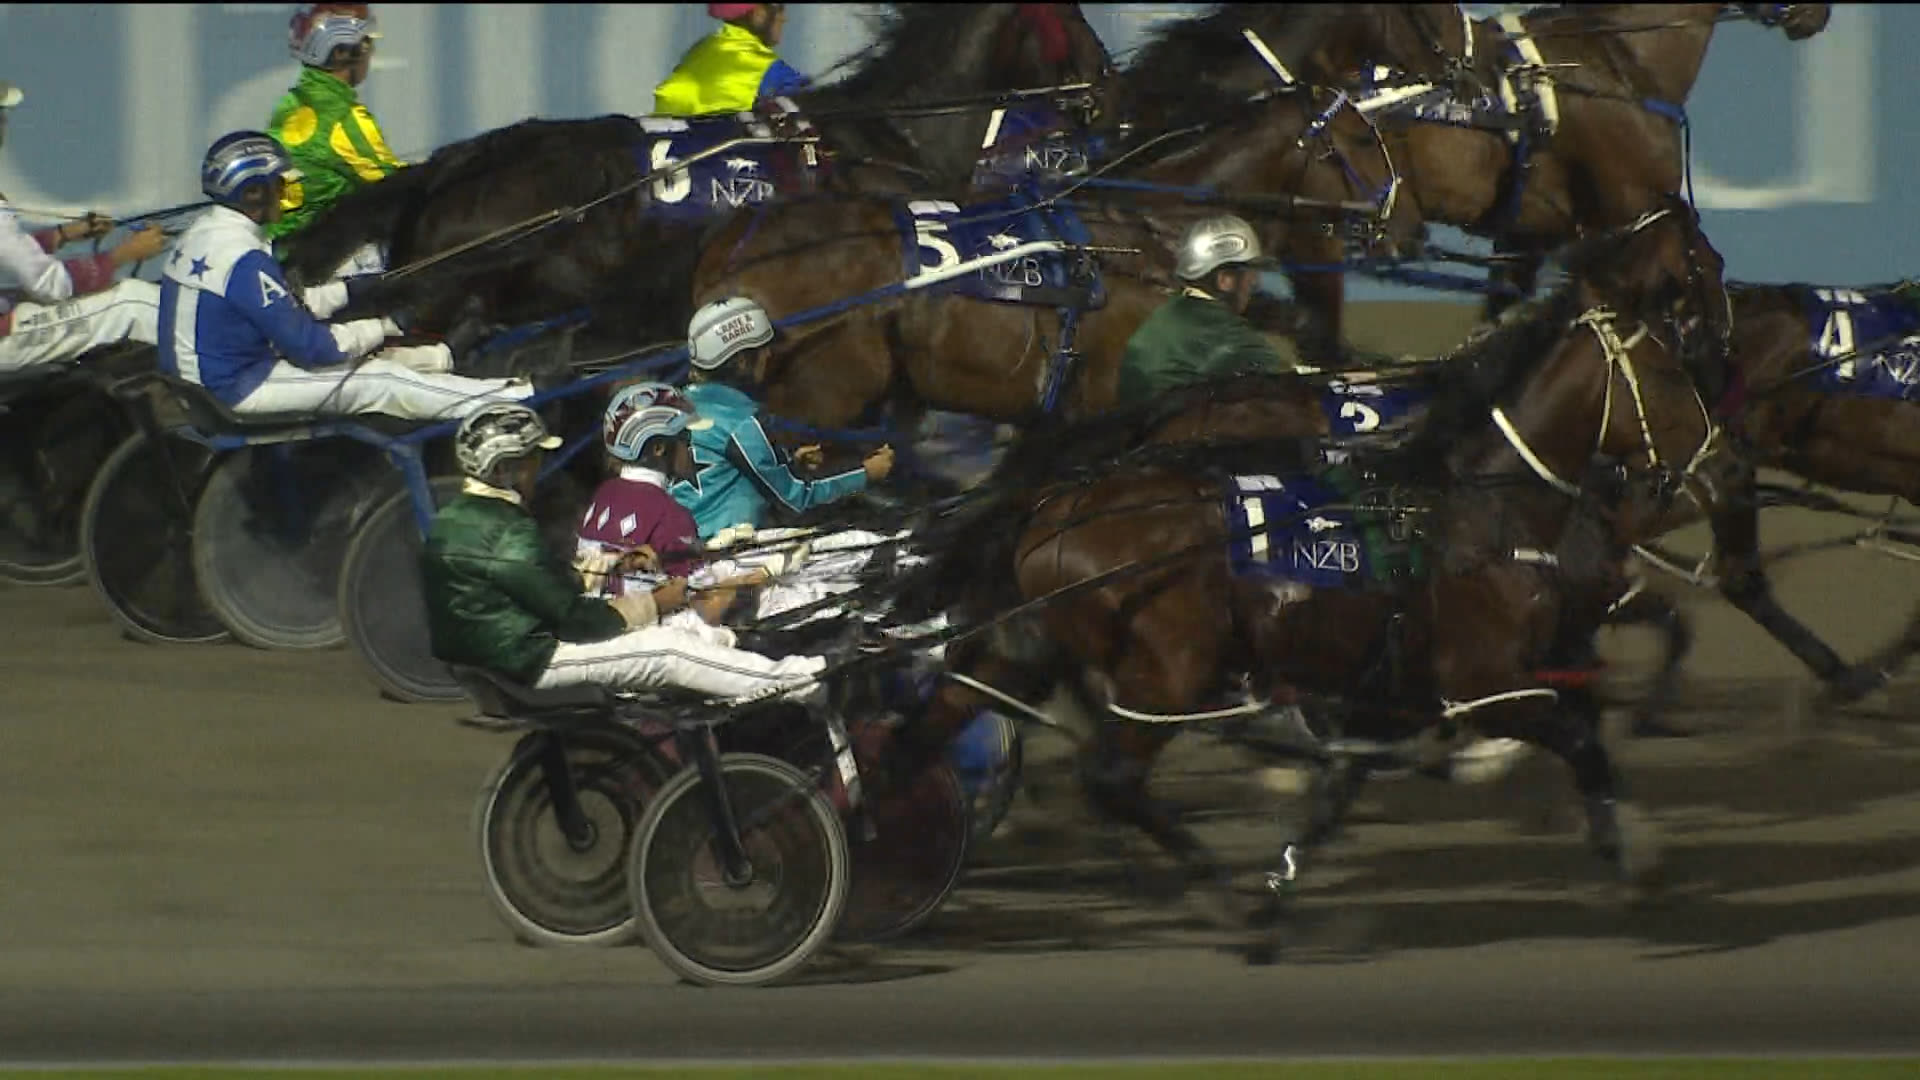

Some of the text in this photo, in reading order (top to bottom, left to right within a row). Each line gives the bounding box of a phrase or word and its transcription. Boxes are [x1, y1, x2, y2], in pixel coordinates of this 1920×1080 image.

[651, 139, 691, 203] 6
[915, 219, 960, 274] 5
[258, 270, 288, 308] A
[1819, 311, 1856, 378] 4
[1243, 496, 1270, 563] 1
[1292, 538, 1360, 573] NZB
